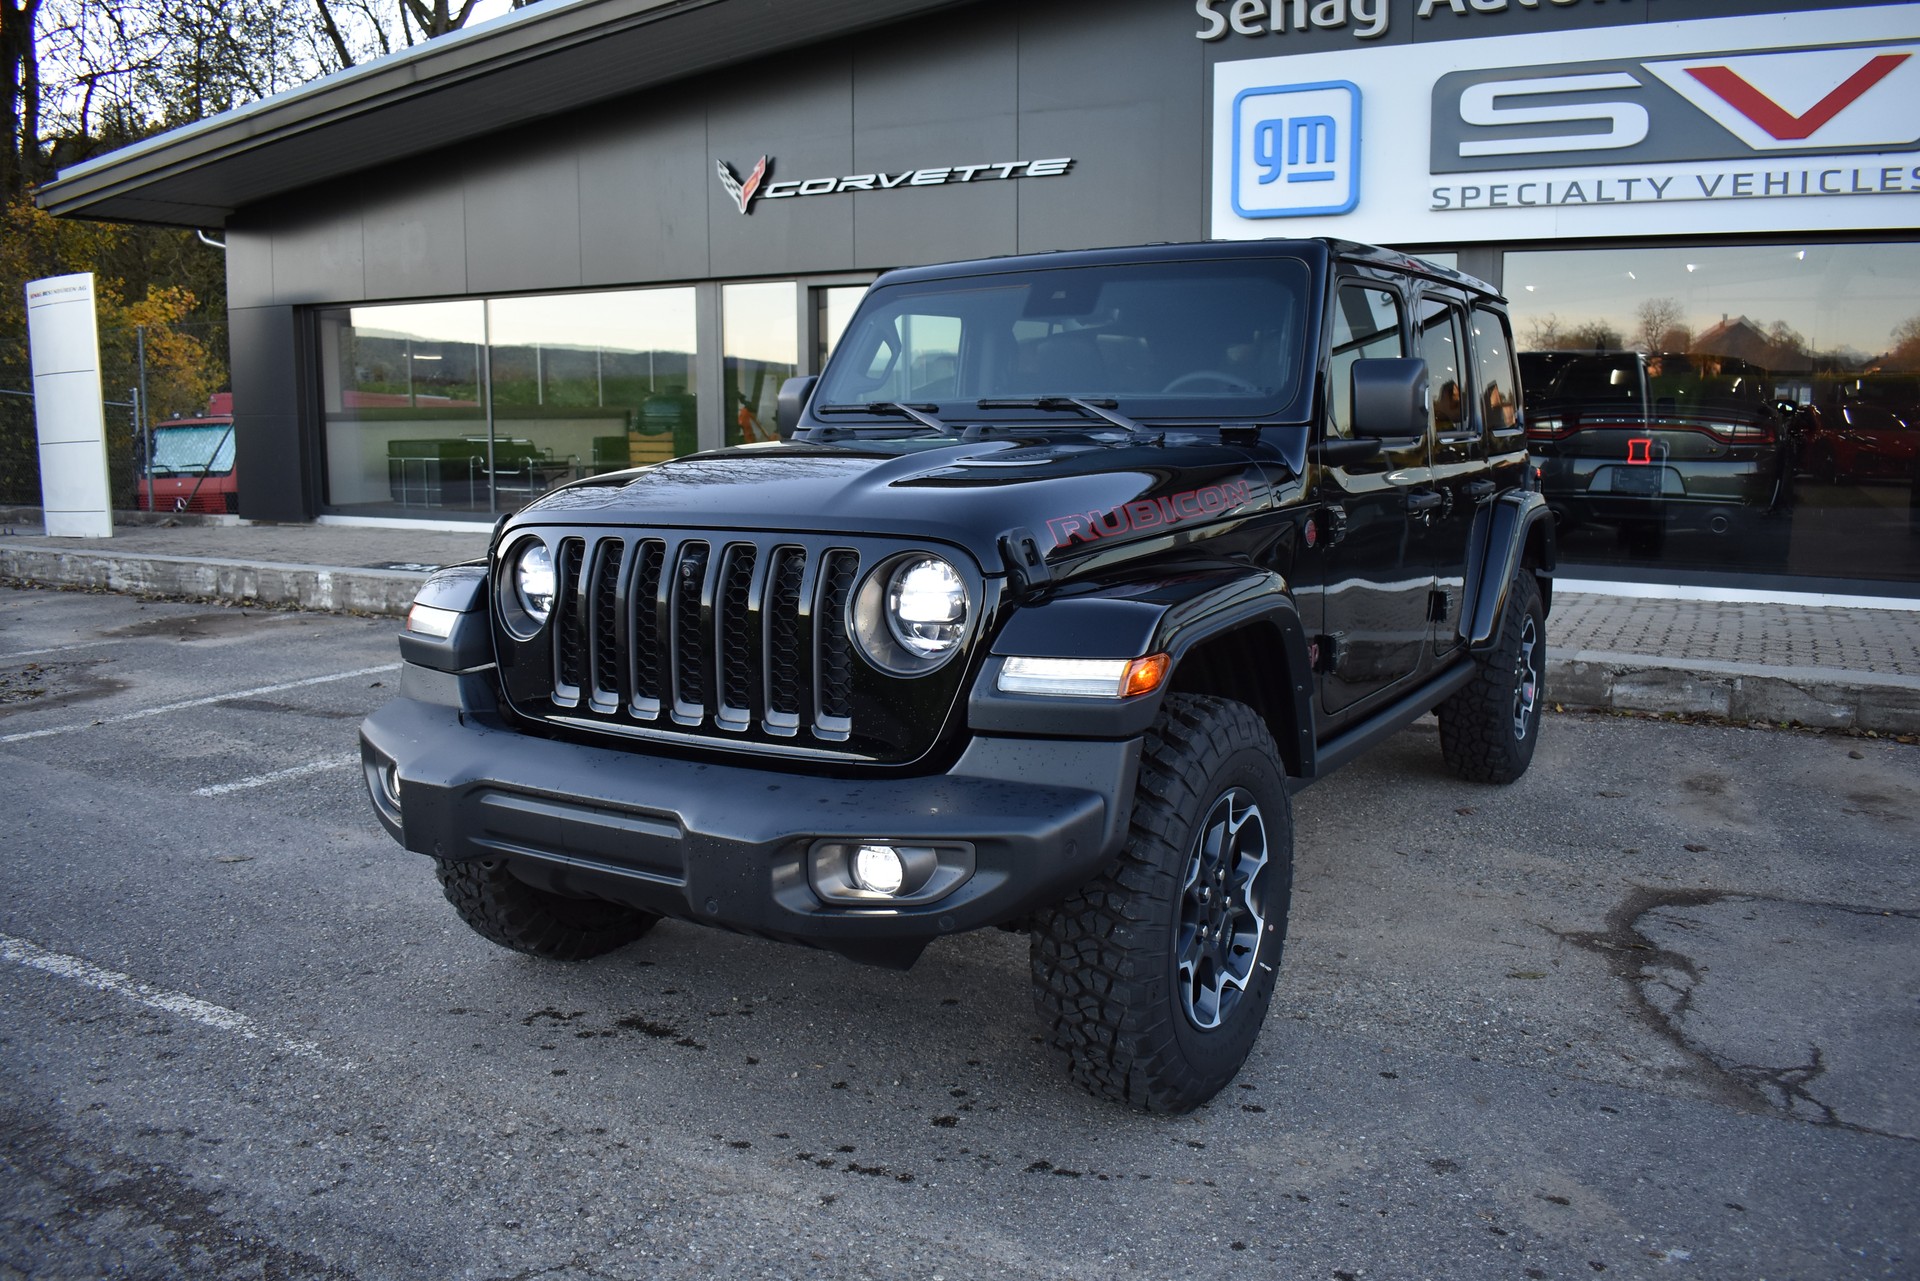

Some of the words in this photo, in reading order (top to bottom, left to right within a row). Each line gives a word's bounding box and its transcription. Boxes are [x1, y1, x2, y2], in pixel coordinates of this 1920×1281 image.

[1195, 0, 1390, 41] Senag
[1253, 115, 1336, 185] gm
[764, 157, 1073, 199] CORVETTE
[1431, 176, 1674, 209] SPECIALTY
[1046, 480, 1253, 548] RUBICON
